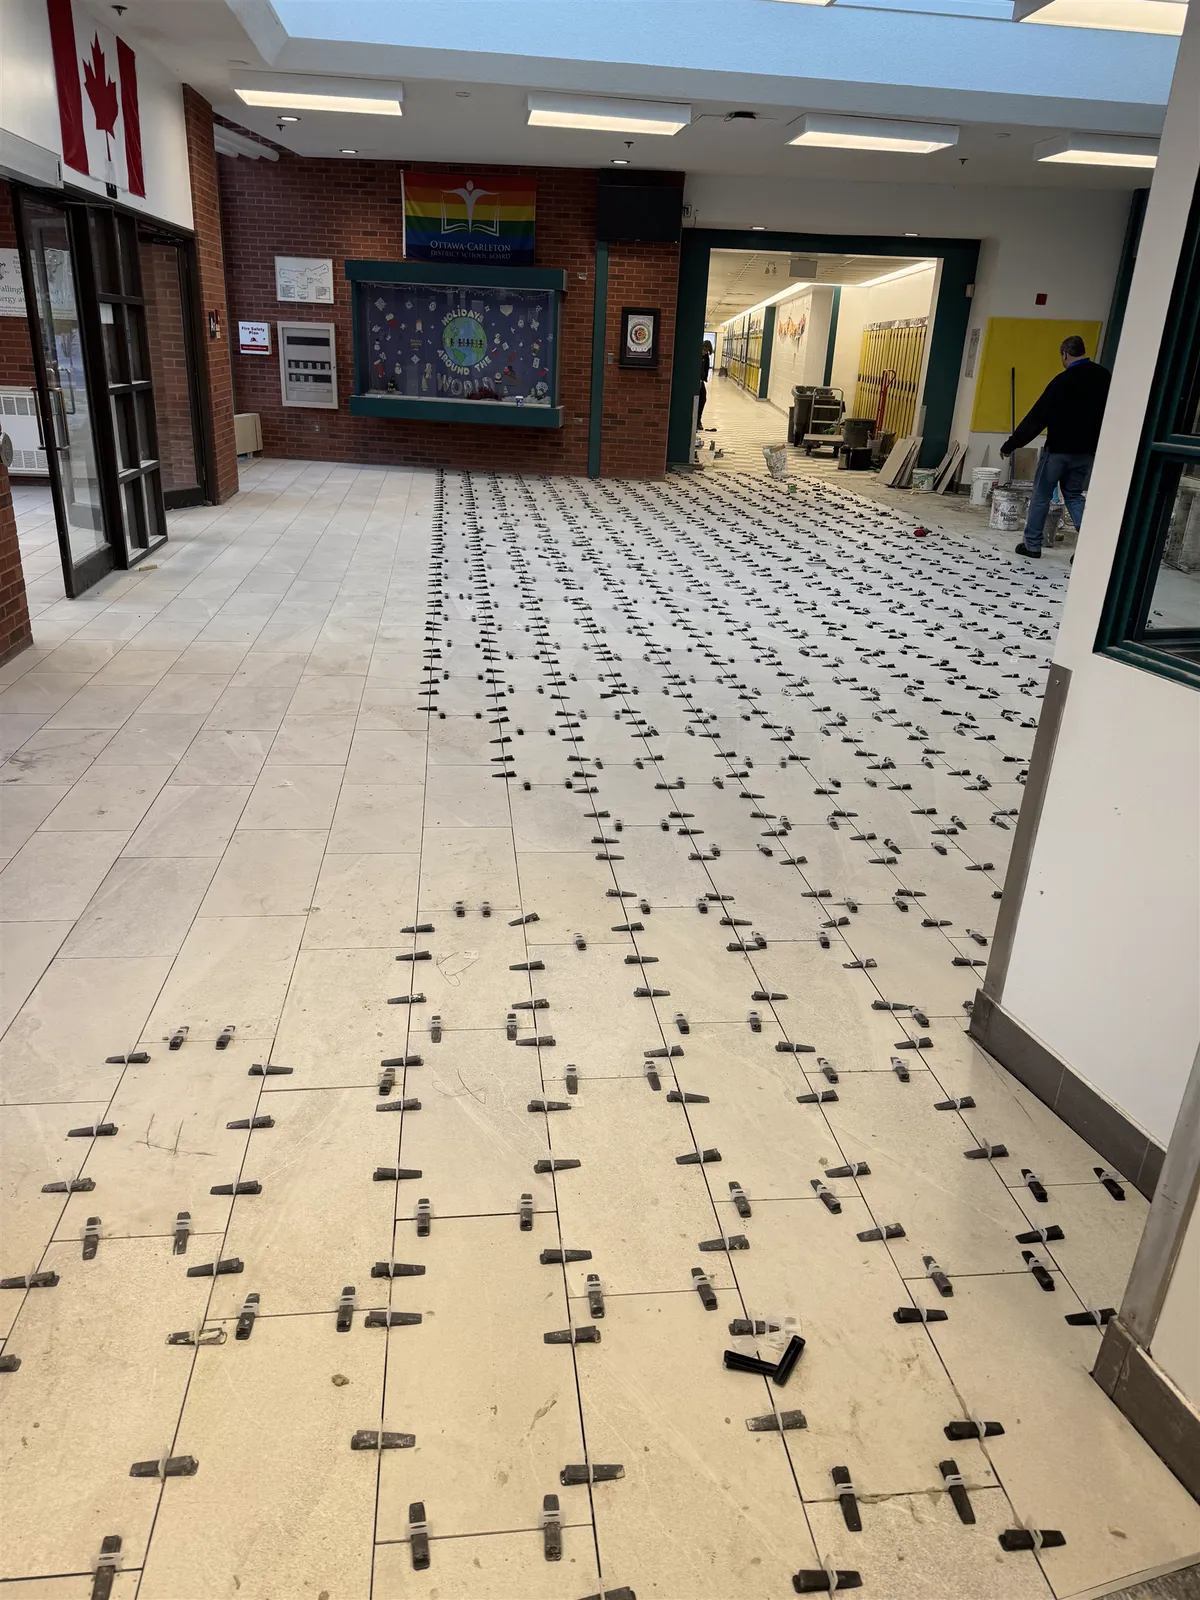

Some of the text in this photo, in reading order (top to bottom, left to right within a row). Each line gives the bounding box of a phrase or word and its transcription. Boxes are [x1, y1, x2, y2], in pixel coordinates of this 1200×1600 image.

[430, 250, 511, 261] DISTRICT SCHOOL BOARD
[437, 349, 492, 375] AROUND THE
[437, 373, 496, 398] WORLD
